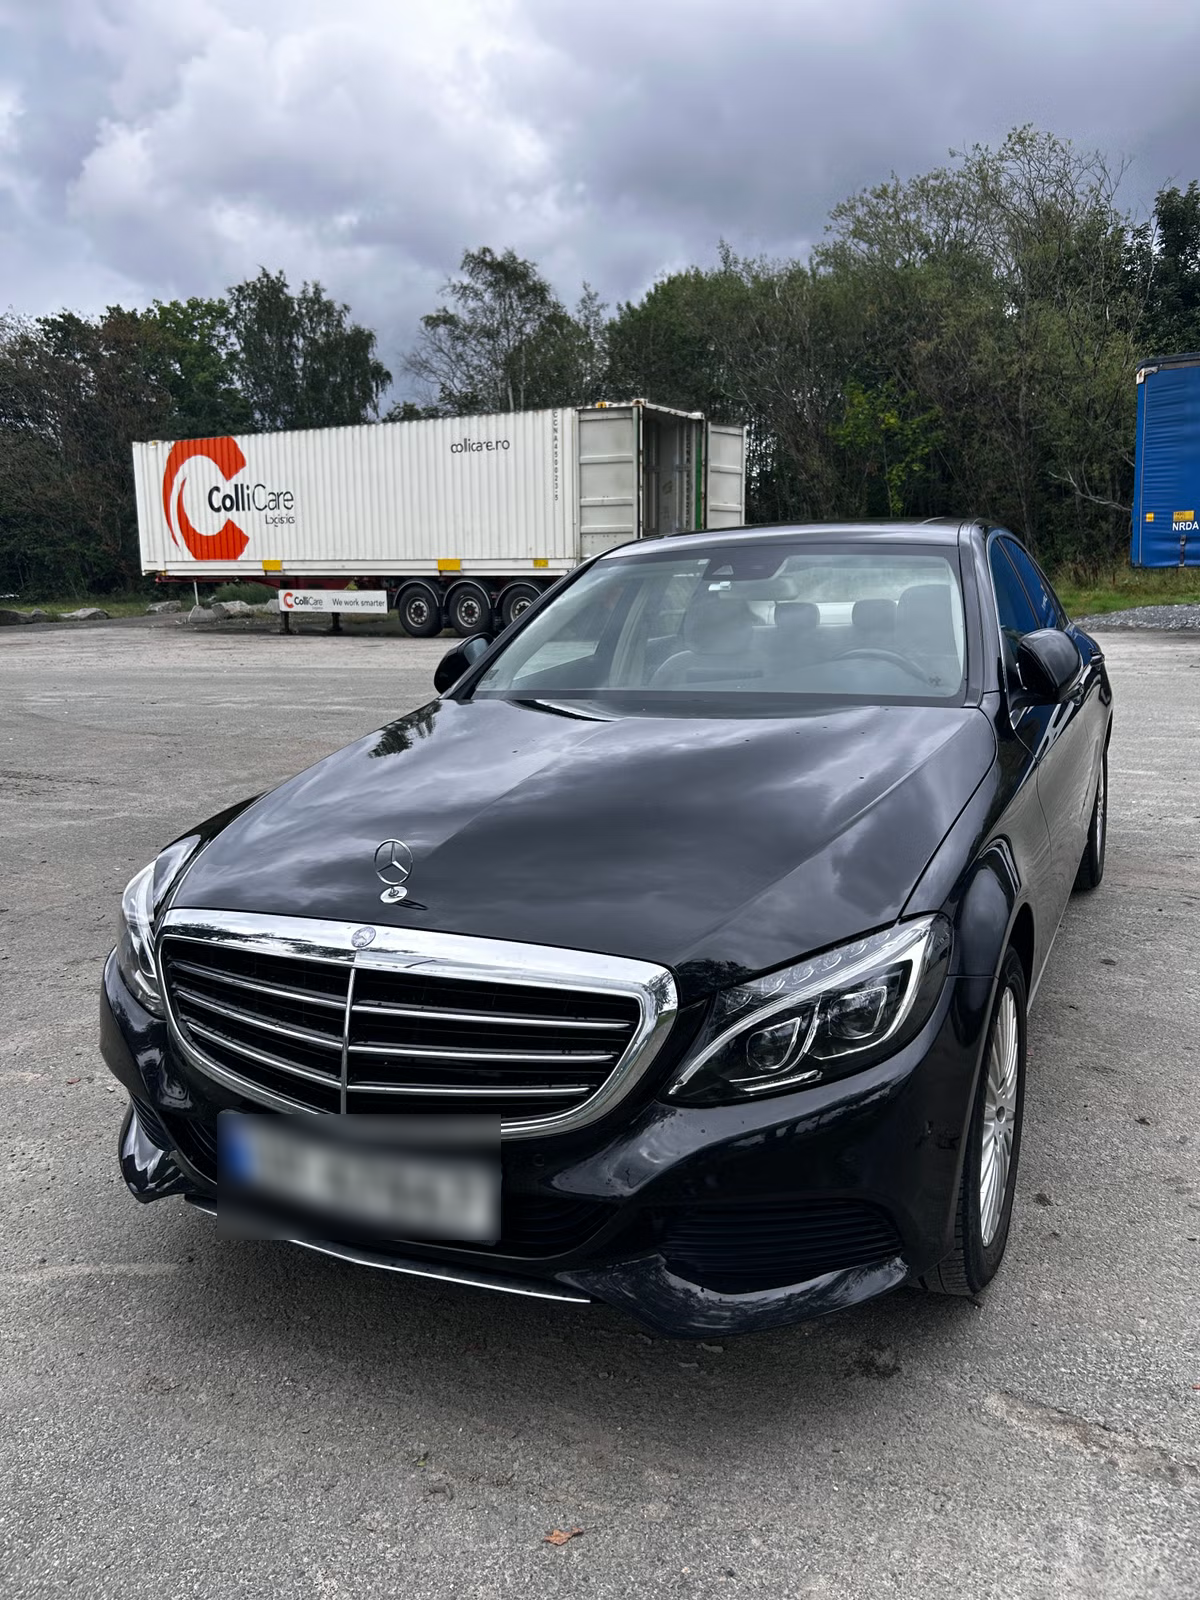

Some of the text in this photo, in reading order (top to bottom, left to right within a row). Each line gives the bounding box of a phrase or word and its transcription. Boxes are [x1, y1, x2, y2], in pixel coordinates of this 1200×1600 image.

[208, 483, 294, 513] ColliCare
[1172, 521, 1199, 531] NRDA
[294, 596, 323, 606] ColliCare
[332, 598, 385, 607] We work smarter
